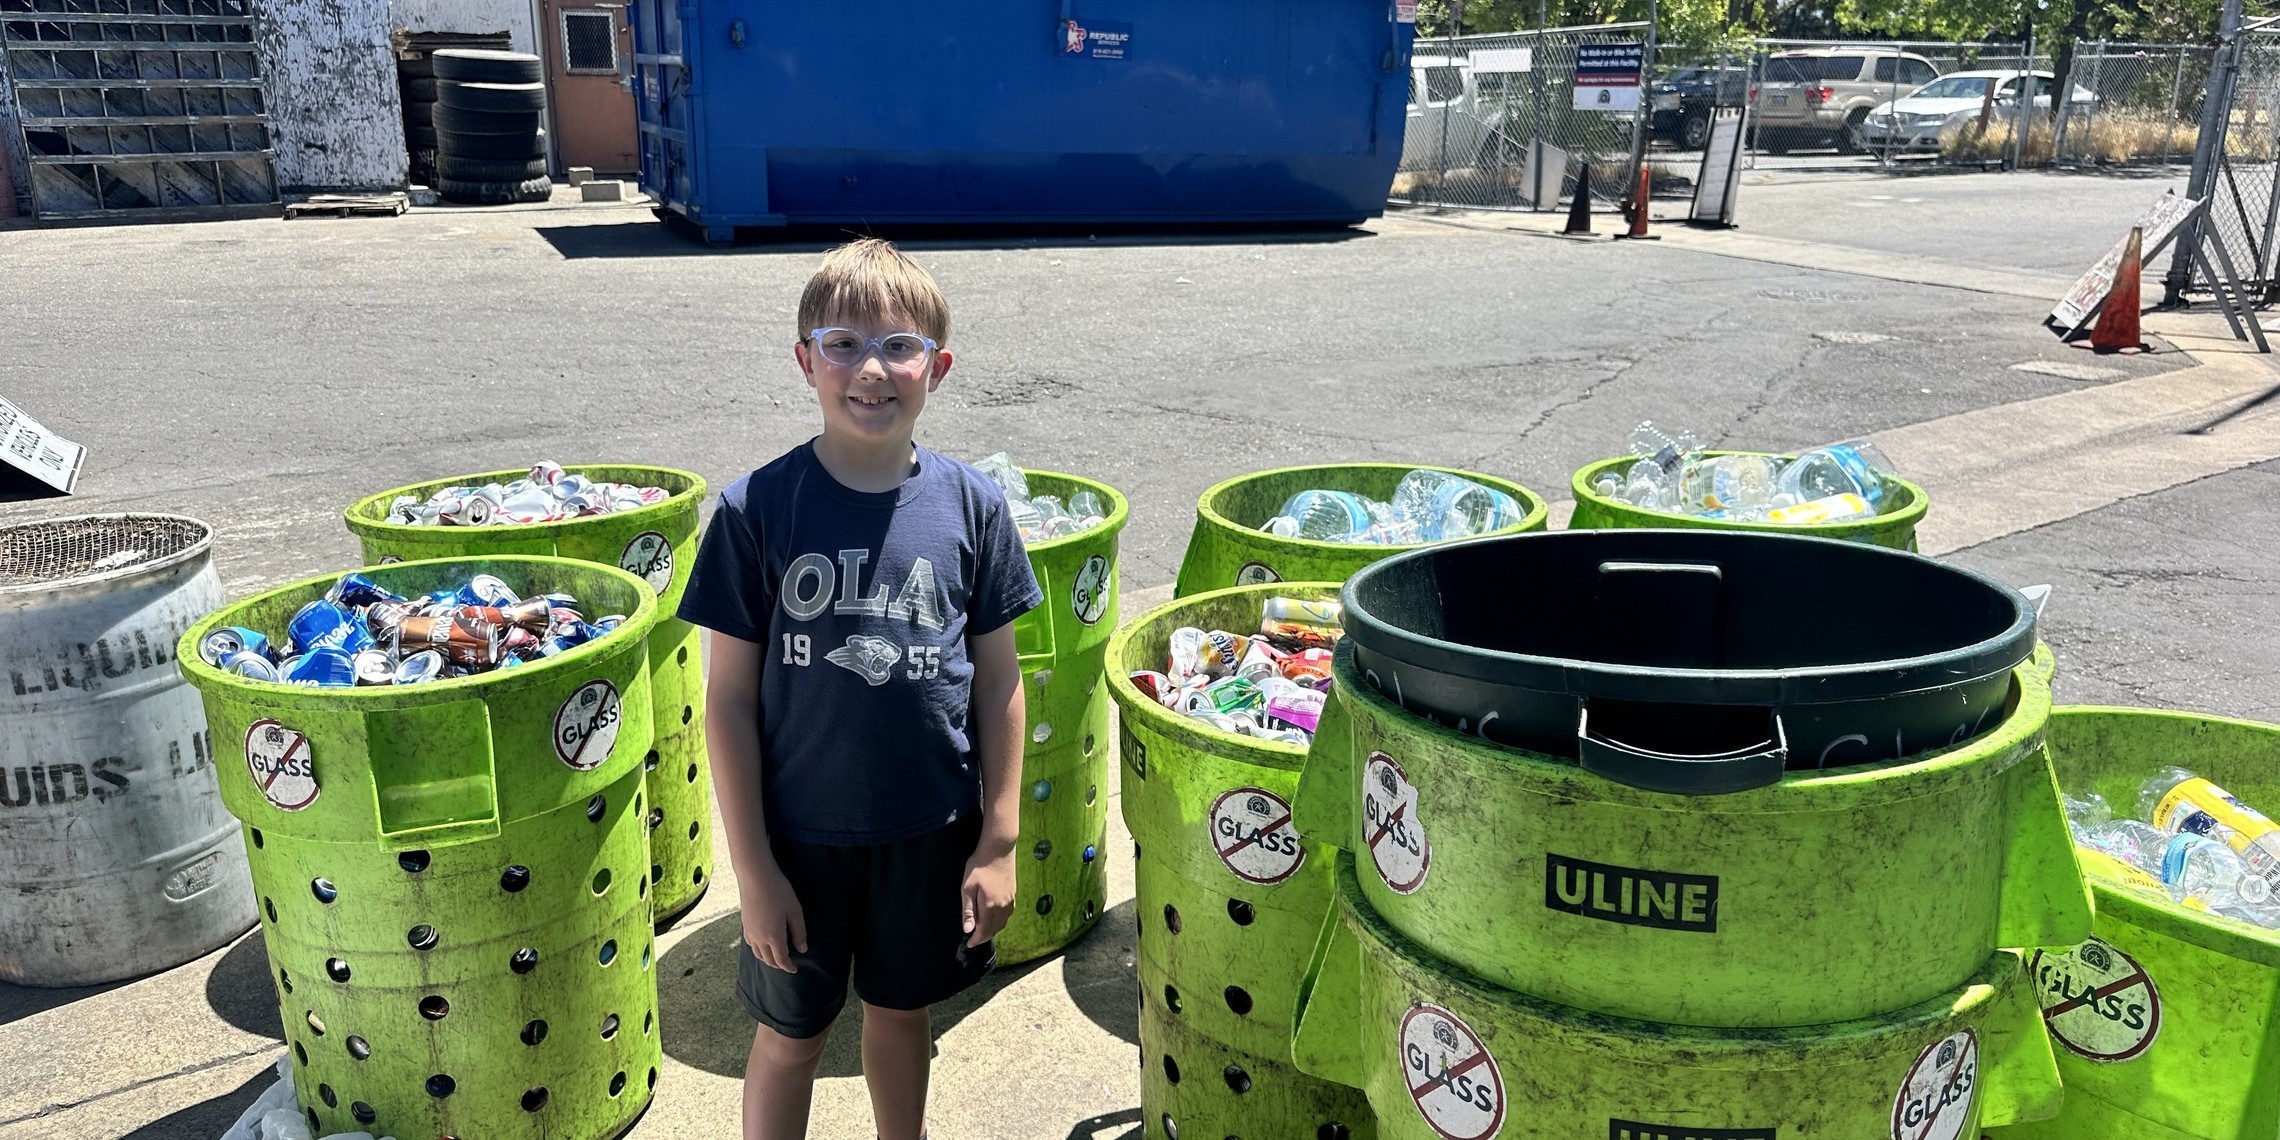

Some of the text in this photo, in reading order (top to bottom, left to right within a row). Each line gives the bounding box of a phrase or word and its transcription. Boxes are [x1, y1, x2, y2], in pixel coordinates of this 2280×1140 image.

[1089, 32, 1129, 41] REPUBLIC
[9, 425, 41, 461] VEHICLES
[39, 446, 64, 471] ONLY
[626, 556, 671, 576] GLASS
[782, 549, 945, 632] OLA
[782, 633, 941, 680] 19 55
[562, 704, 619, 745] GLASS
[252, 752, 312, 778] GLASS
[1218, 816, 1296, 856] GLASS
[1556, 865, 1709, 923] ULINE
[2040, 965, 2146, 1030] GLASS
[1407, 1043, 1493, 1112] GLASS
[1904, 1062, 1974, 1128] GLASS
